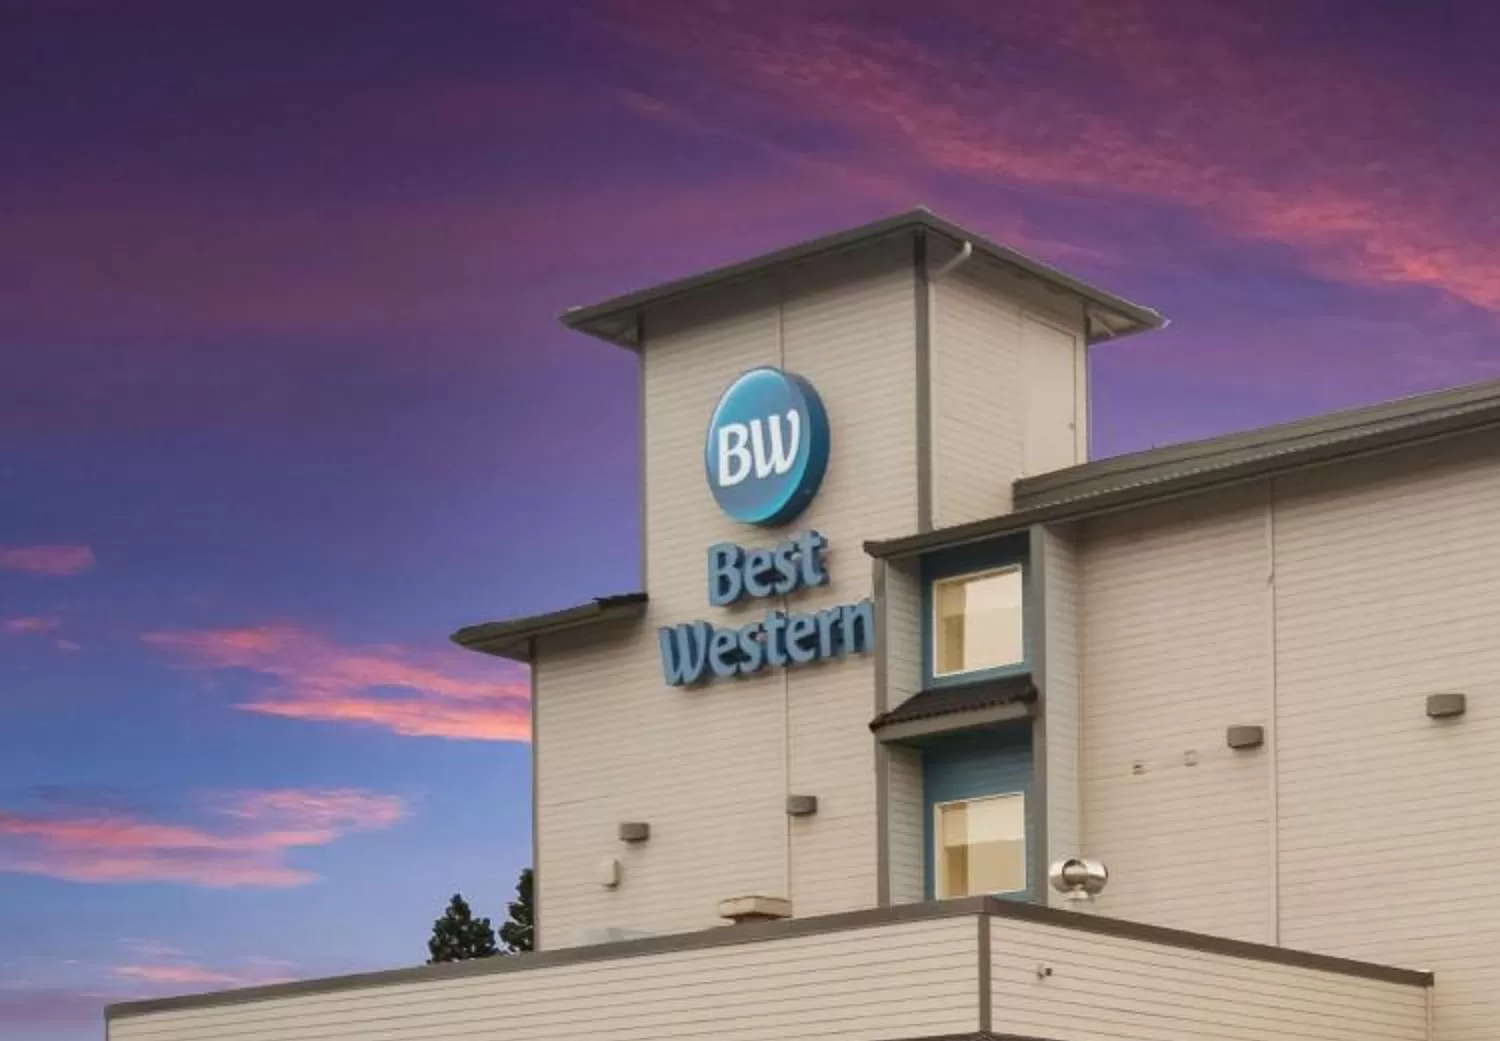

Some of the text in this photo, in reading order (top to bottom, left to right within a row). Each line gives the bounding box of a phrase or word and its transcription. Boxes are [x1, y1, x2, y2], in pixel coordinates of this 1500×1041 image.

[718, 408, 800, 487] BW
[708, 530, 828, 607] Best
[659, 599, 875, 687] Western
